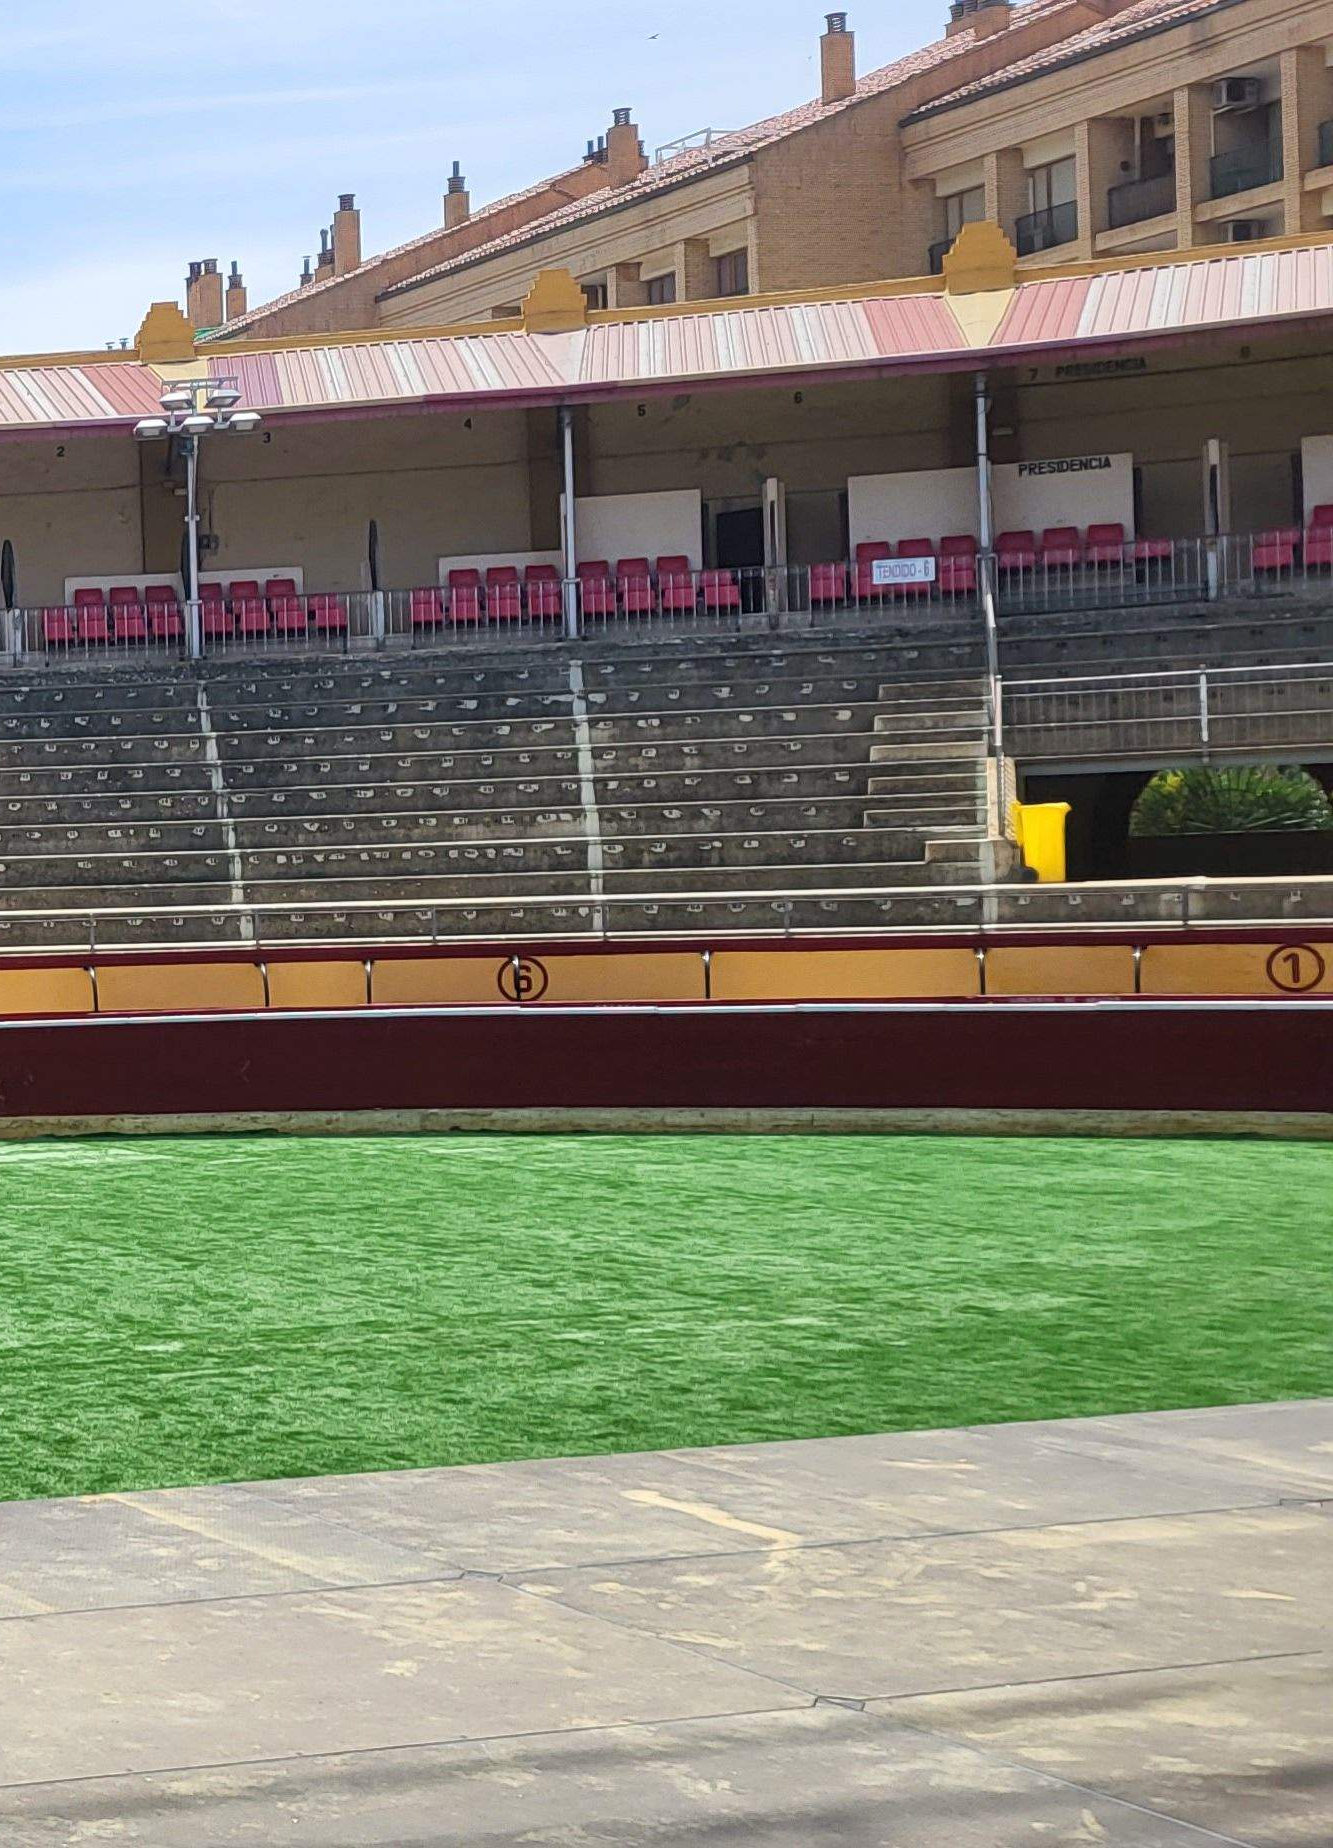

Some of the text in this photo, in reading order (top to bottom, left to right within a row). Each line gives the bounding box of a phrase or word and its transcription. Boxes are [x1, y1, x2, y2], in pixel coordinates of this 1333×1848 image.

[1055, 357, 1147, 378] PRESIDENCIA
[464, 418, 473, 429] 4
[263, 432, 271, 443] 3
[56, 446, 65, 457] 2
[1018, 456, 1111, 477] PRESIDENCIA
[1283, 953, 1300, 983] 1
[514, 965, 532, 993] 6
